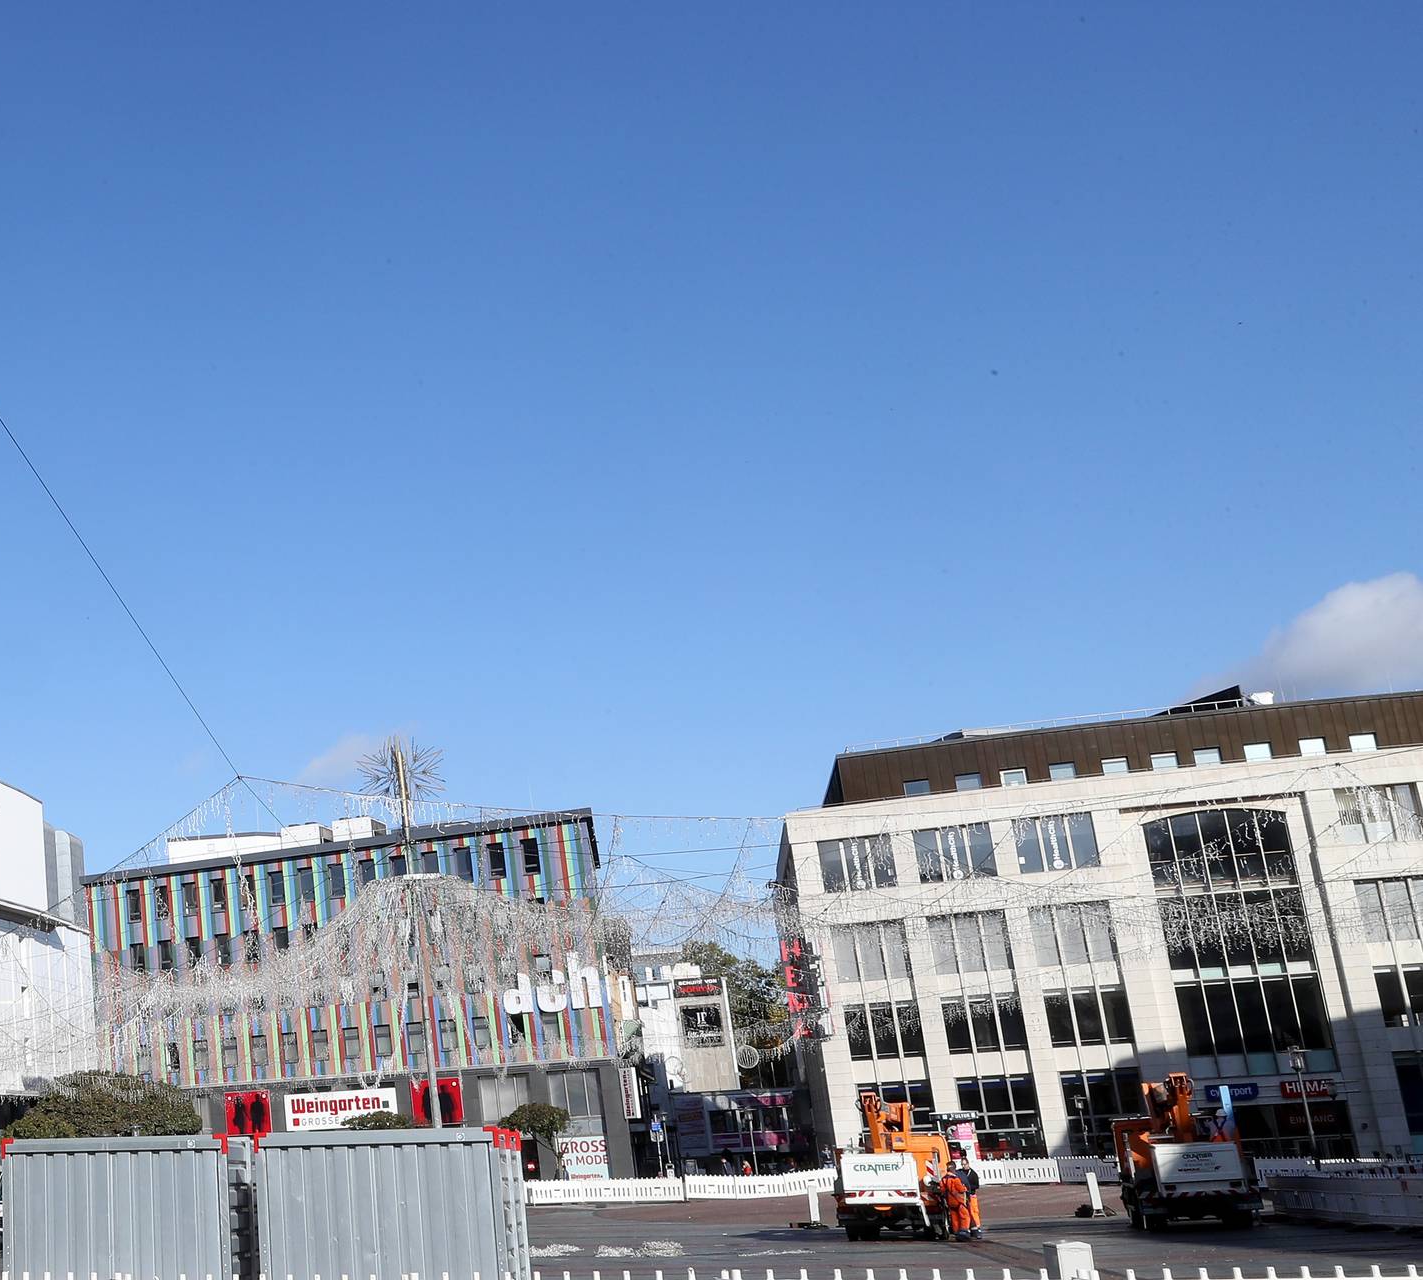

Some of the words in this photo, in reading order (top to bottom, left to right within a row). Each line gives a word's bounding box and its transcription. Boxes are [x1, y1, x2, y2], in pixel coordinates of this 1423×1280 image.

[1048, 820, 1061, 860] HealthCity
[1210, 1087, 1253, 1097] cyrport
[302, 1116, 339, 1126] GROSSE
[1289, 1114, 1335, 1124] EINANG
[853, 1163, 899, 1176] CRAMER
